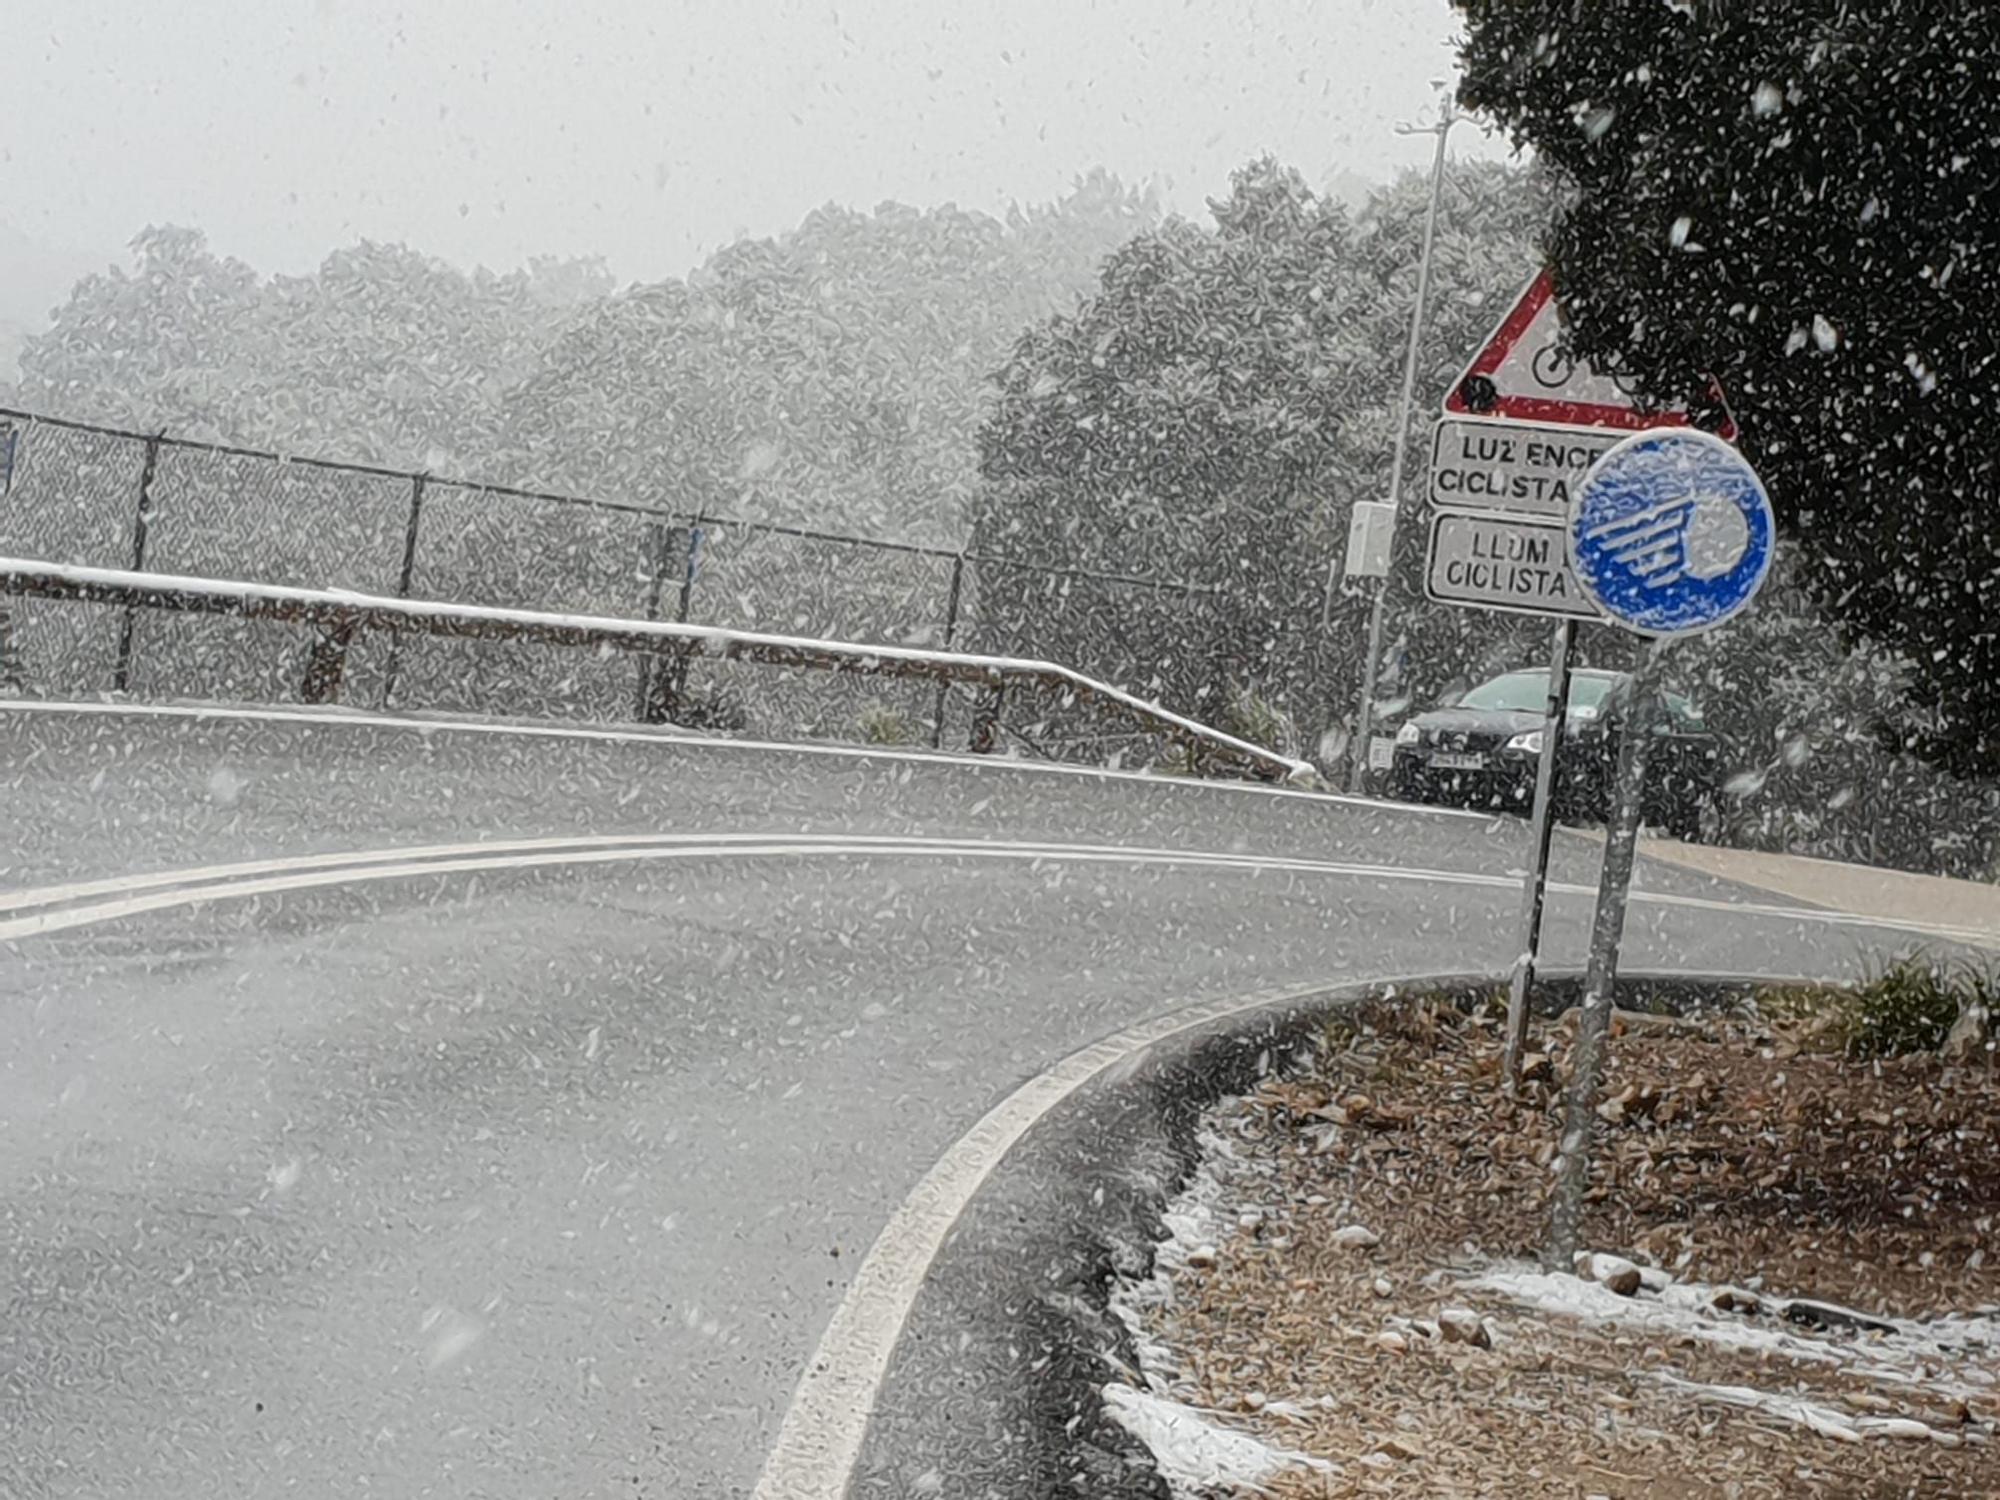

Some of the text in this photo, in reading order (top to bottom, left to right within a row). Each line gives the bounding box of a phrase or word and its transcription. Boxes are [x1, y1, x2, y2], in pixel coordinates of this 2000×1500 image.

[1462, 436, 1516, 463] LUZ
[1472, 532, 1549, 564] LLUM
[1447, 561, 1566, 597] CICLISTA
